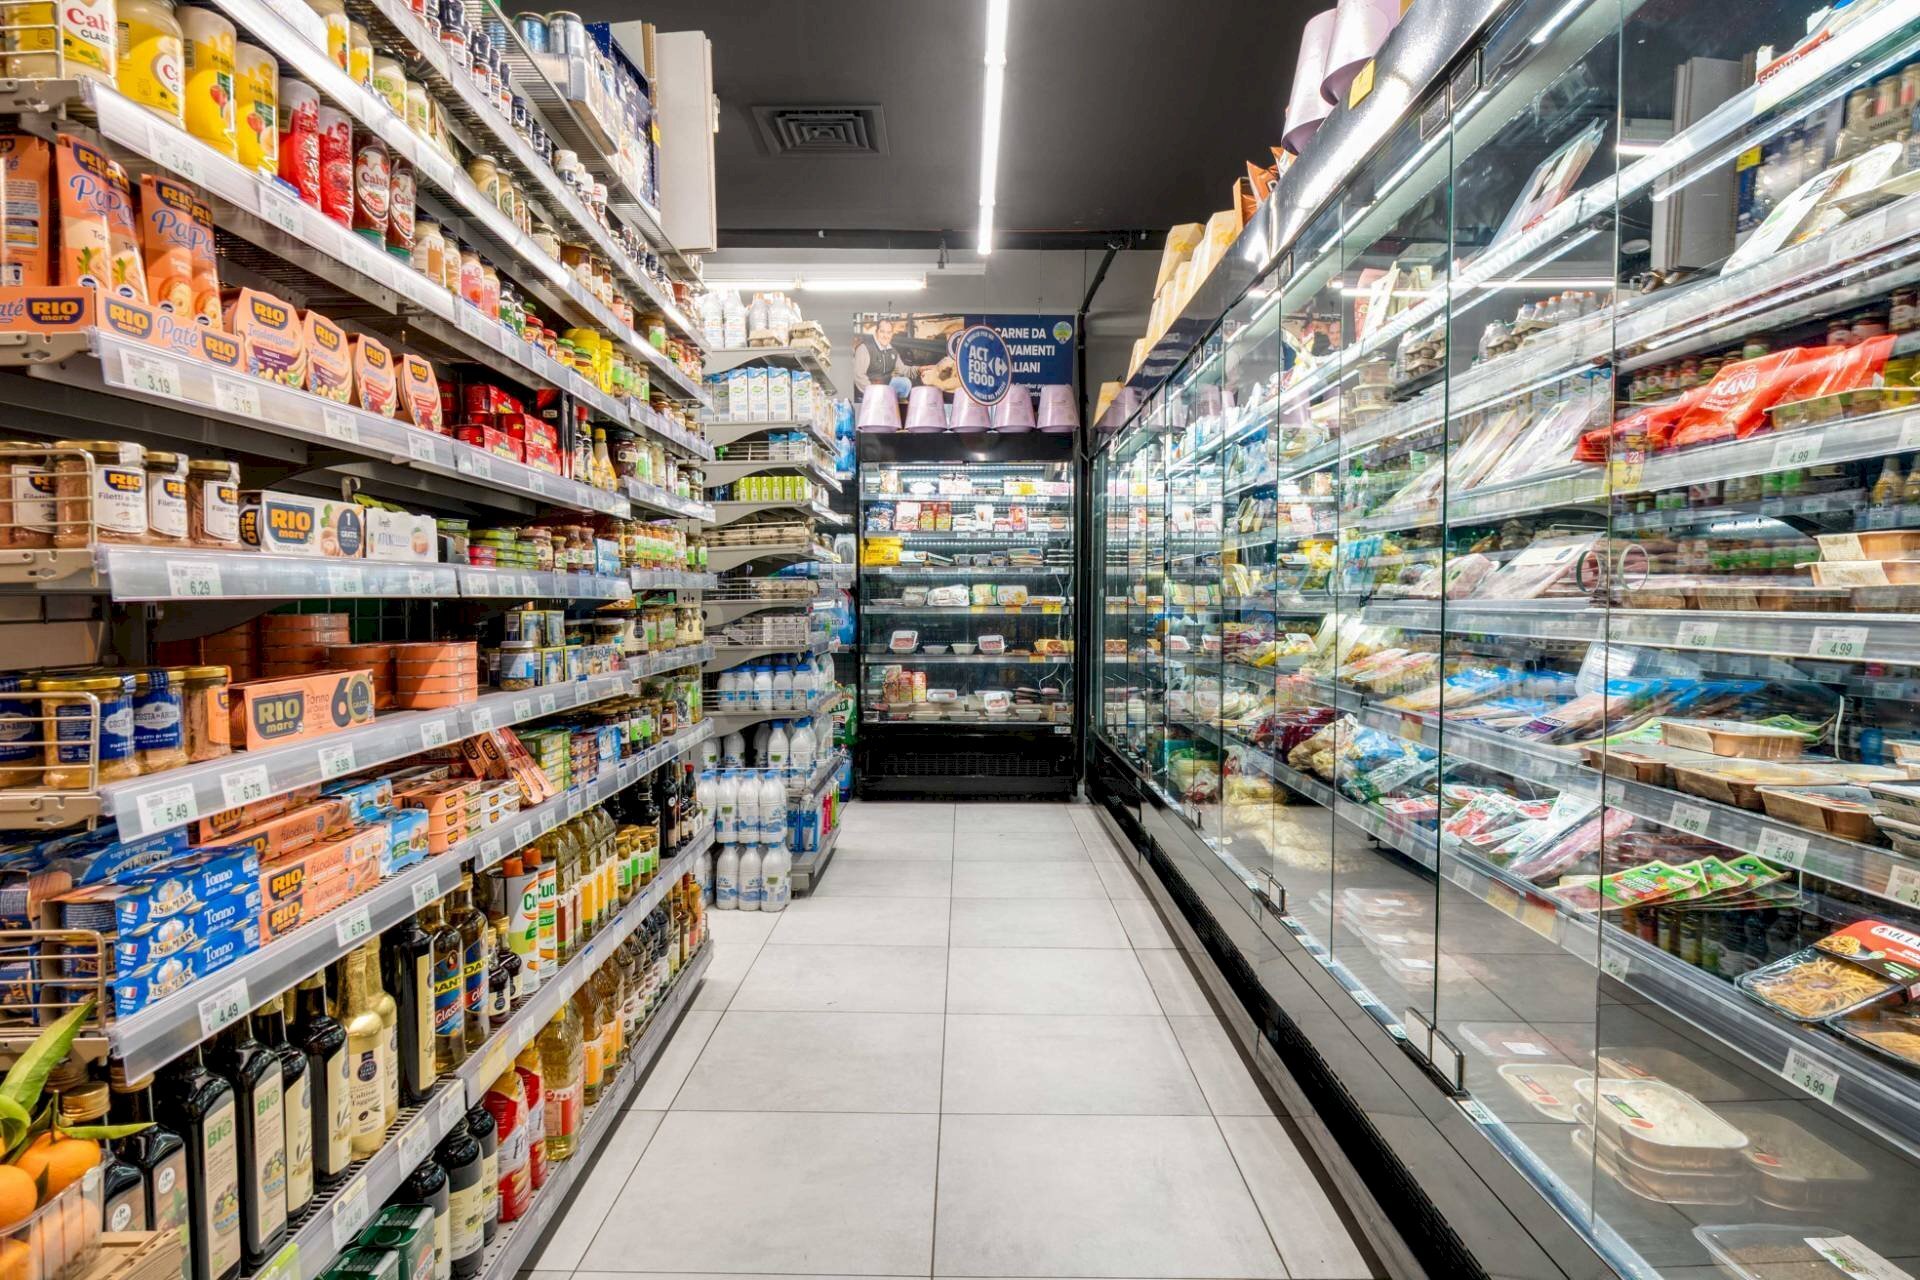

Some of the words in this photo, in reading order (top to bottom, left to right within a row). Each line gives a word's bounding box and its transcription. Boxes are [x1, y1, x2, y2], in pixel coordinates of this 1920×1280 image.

[32, 301, 78, 315] RIO
[110, 304, 149, 331] RIO
[254, 302, 285, 324] RIO
[157, 315, 198, 350] Paté
[316, 325, 338, 344] RIO
[995, 327, 1030, 339] ARNE
[1031, 327, 1047, 339] DA
[205, 335, 237, 357] RIO
[366, 346, 385, 363] RIO
[969, 345, 989, 362] ACT
[968, 359, 988, 374] FOR
[968, 371, 995, 387] FOOD
[1712, 372, 1758, 396] RANA
[109, 473, 142, 486] RIO
[270, 508, 312, 532] RIO
[279, 528, 305, 541] mare
[258, 698, 300, 725] RIO
[266, 721, 295, 734] mare
[202, 868, 233, 889] Tonno
[272, 868, 302, 890] RIO
[538, 883, 555, 899] uo
[204, 905, 236, 926] Tonno
[271, 901, 300, 926] RIO
[203, 940, 234, 964] Tonno
[257, 1089, 280, 1117] BIO
[207, 1119, 233, 1149] BIO
